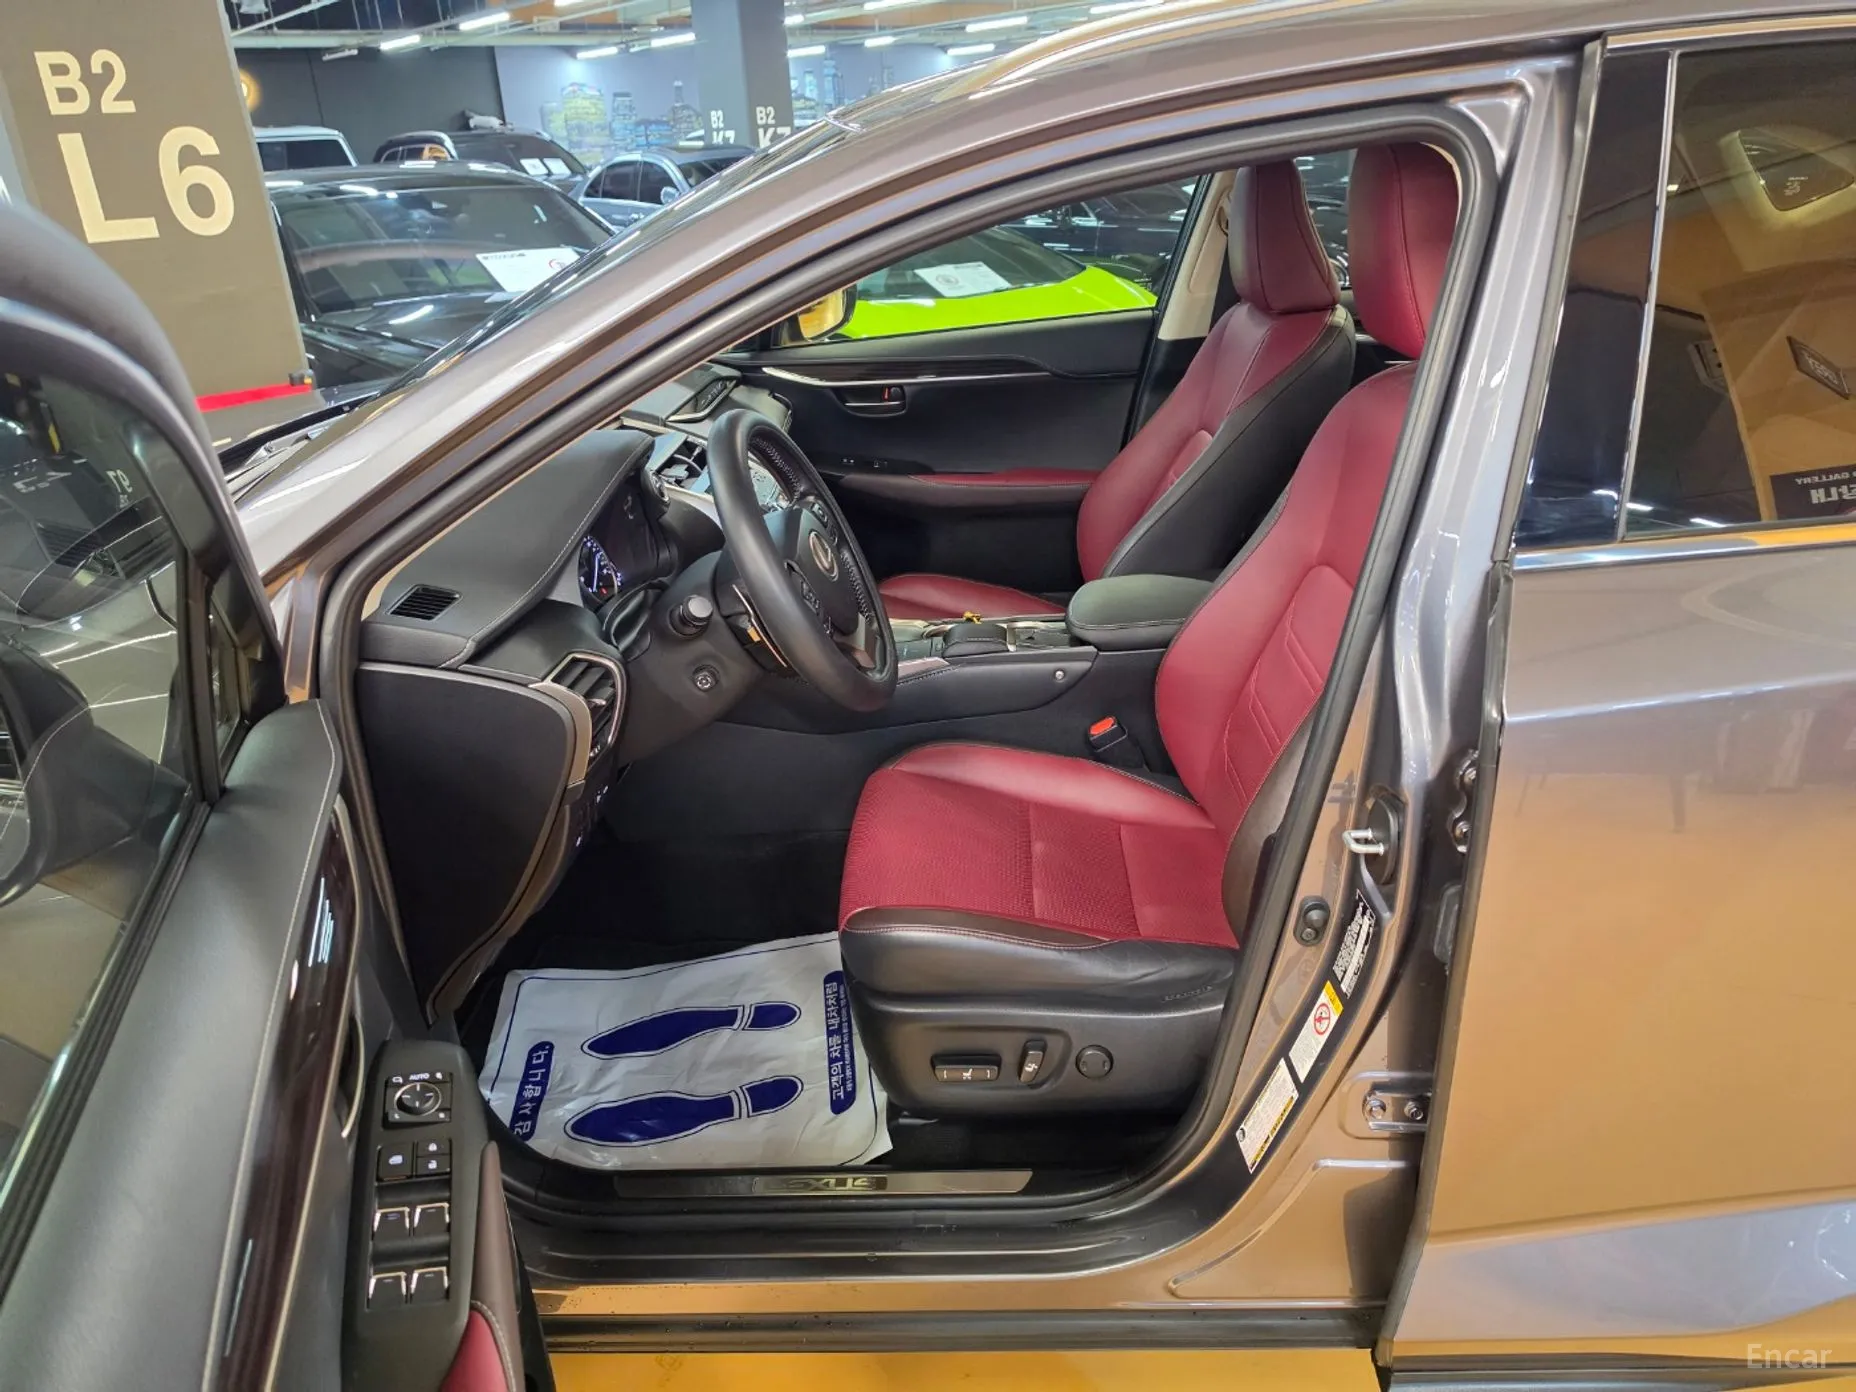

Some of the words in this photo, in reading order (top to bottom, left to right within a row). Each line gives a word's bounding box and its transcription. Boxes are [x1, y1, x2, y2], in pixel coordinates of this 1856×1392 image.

[34, 48, 137, 116] B2
[710, 109, 724, 129] B2
[755, 105, 776, 125] B2
[57, 125, 235, 244] L6
